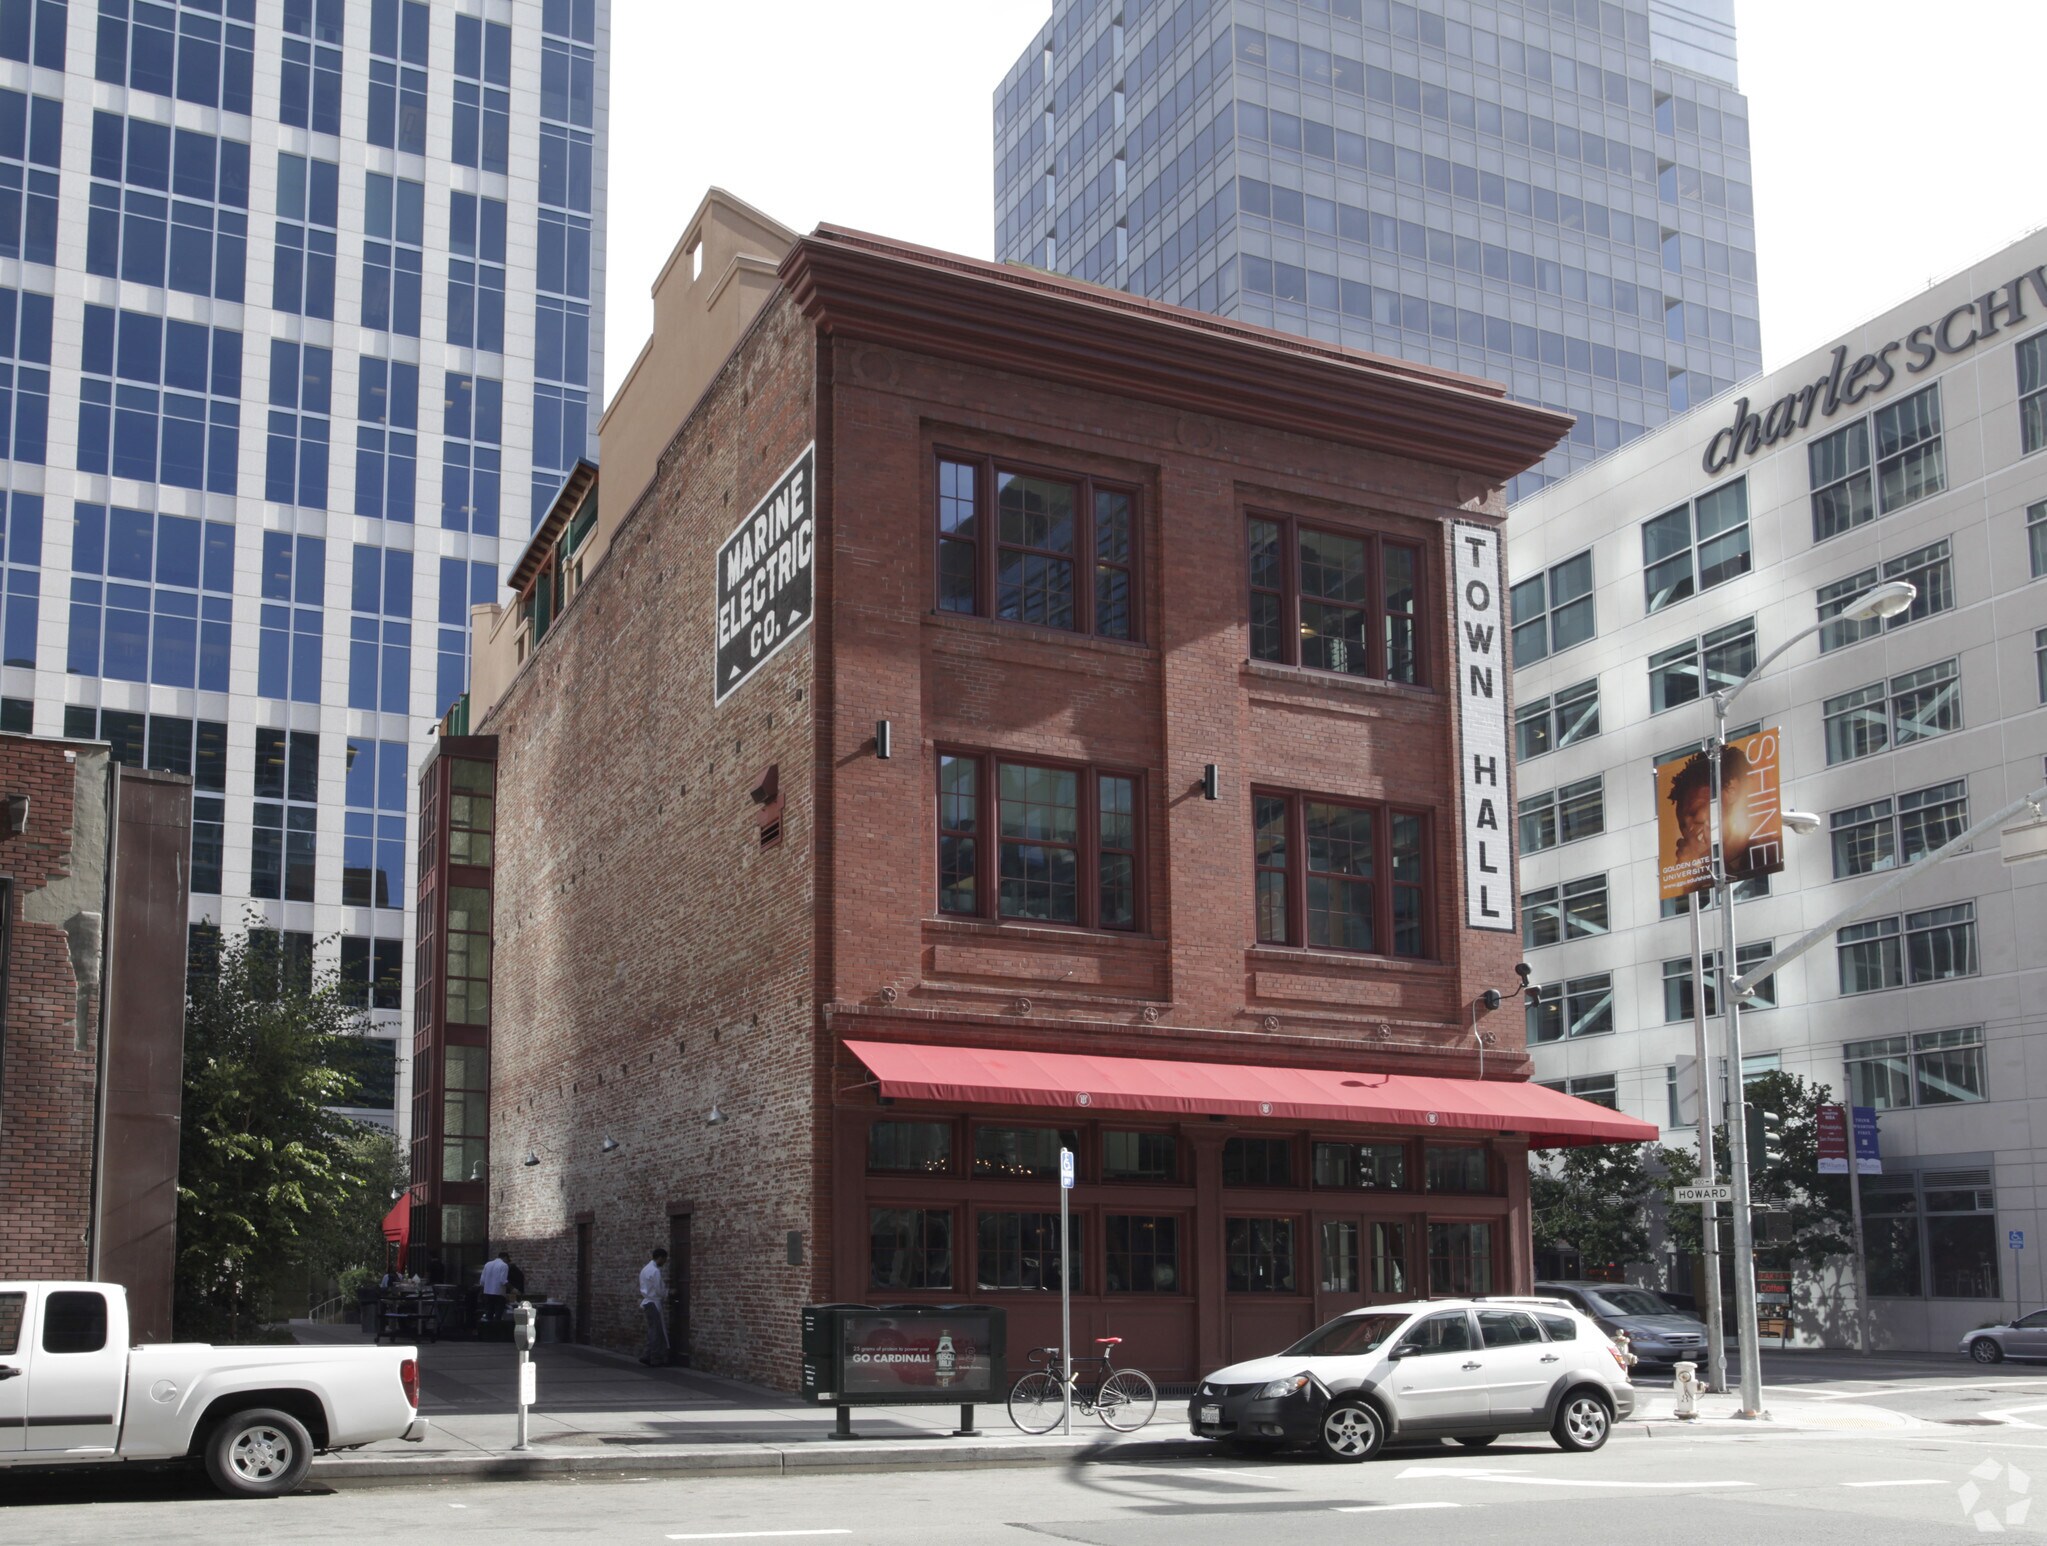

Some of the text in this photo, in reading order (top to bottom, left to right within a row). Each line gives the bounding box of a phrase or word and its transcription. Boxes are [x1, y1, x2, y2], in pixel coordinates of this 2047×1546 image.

[1702, 341, 1901, 474] charles
[727, 469, 804, 592] MARINE
[719, 519, 811, 650] ELECTRIC
[750, 610, 781, 658] CO.
[1465, 536, 1501, 919] TOWN HALL
[1745, 734, 1779, 870] SHINE
[1663, 856, 1710, 873] GOLDEN GATE
[1663, 865, 1711, 881] UNIVERSITY
[1679, 1189, 1727, 1199] HOWARD
[1760, 1283, 1786, 1293] Coffee
[853, 1353, 930, 1363] GO CARDINAL!
